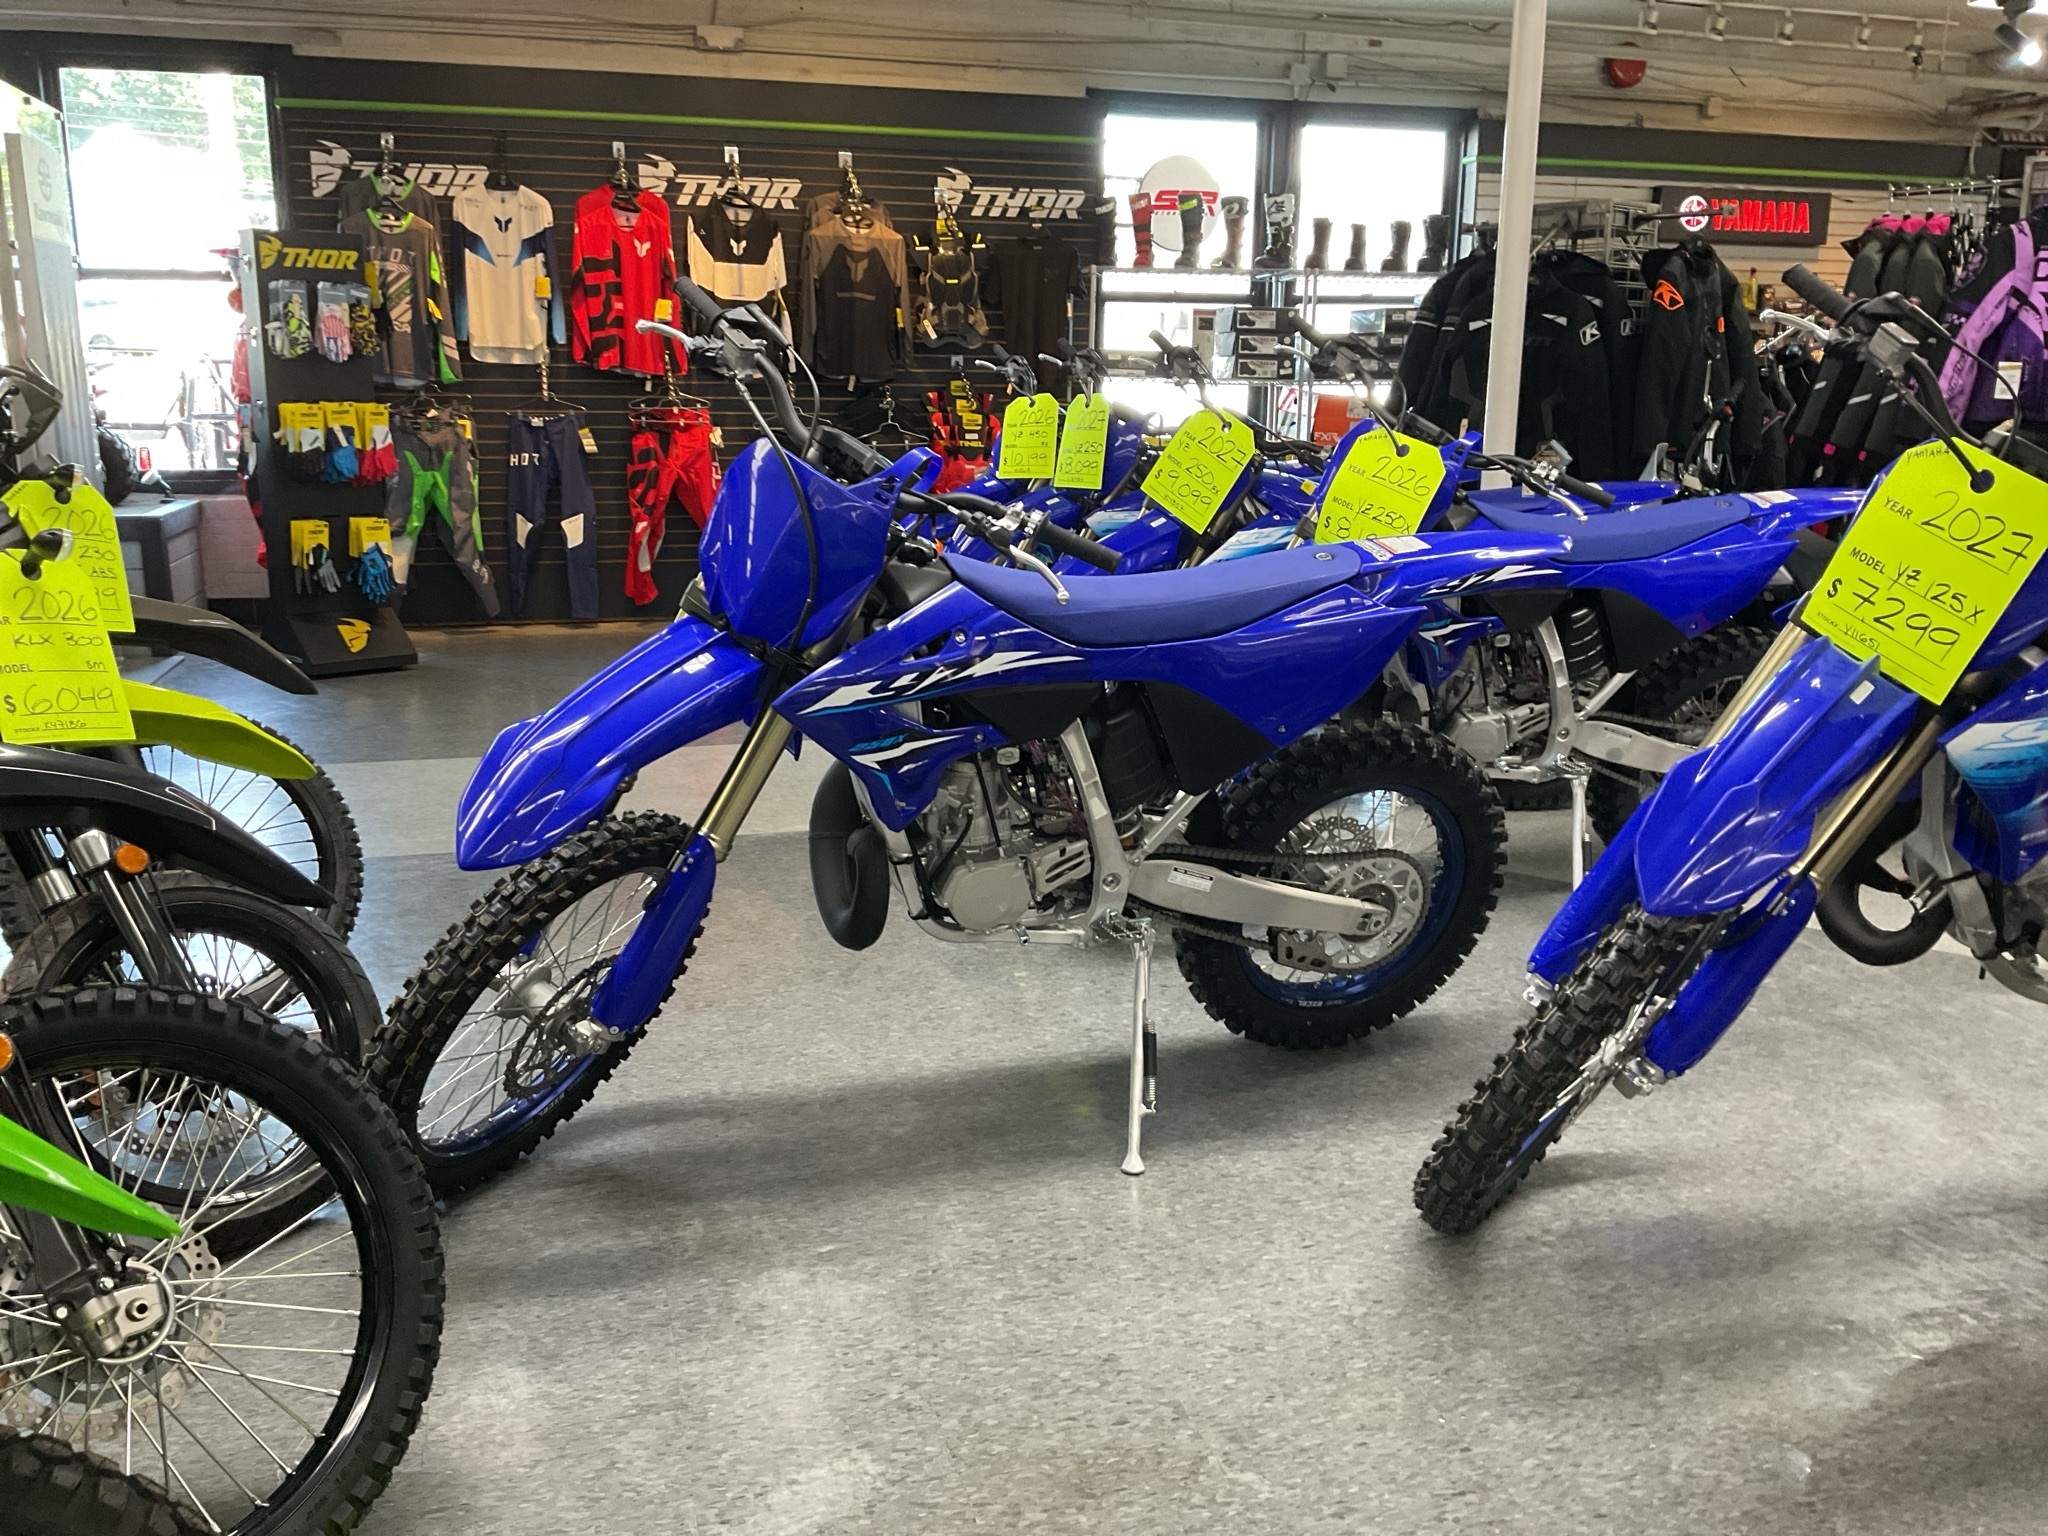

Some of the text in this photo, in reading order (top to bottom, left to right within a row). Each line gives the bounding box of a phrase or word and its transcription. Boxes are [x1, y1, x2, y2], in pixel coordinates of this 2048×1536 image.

[970, 187, 1085, 220] THOR
[1711, 198, 1810, 233] YAMAHA
[282, 247, 359, 271] THOR
[1019, 409, 1056, 427] 2026
[1197, 426, 1248, 470] 2027
[1314, 431, 1341, 443] FXR
[1359, 433, 1388, 444] YAMAHA
[1906, 447, 1950, 463] YAMAHA
[1154, 468, 1163, 479] $
[1185, 457, 1215, 485] 250
[1348, 455, 1431, 497] YEAR 2026
[1332, 495, 1354, 511] MODEL
[42, 506, 117, 540] 2026
[1323, 515, 1332, 529] $
[1883, 490, 2034, 571] YEAR 2027
[79, 545, 117, 561] 230
[1849, 546, 1887, 575] MODEL
[1827, 577, 1843, 600] $
[13, 586, 98, 622] 2026
[12, 632, 105, 649] KLX 300
[3, 694, 17, 715] $
